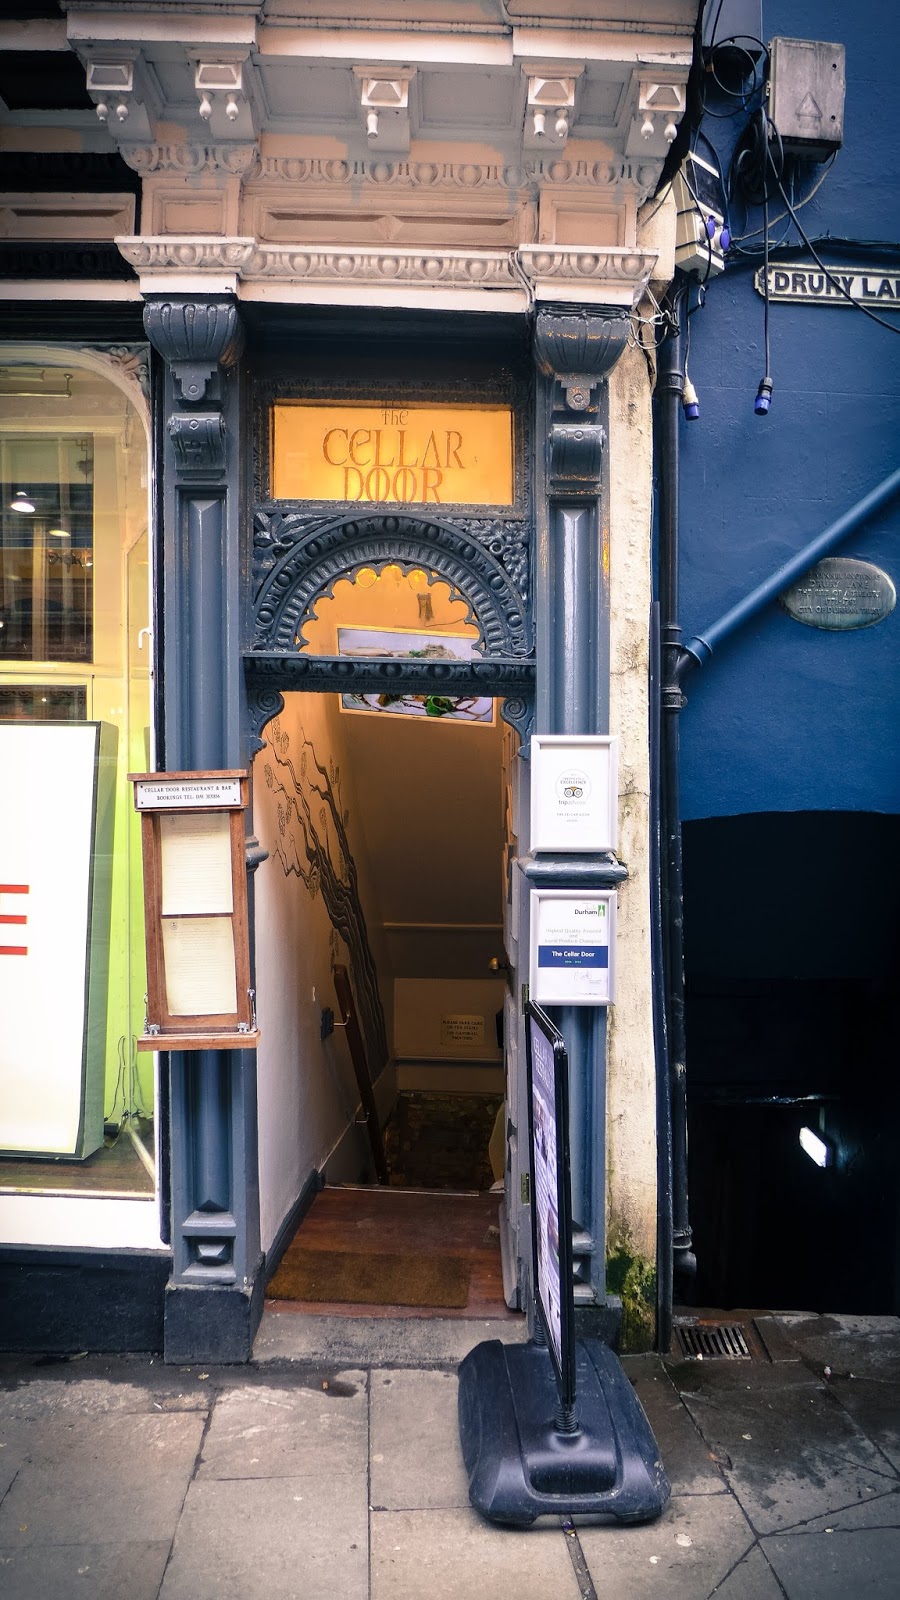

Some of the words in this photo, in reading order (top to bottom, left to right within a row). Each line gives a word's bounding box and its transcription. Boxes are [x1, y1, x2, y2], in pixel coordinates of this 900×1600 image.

[774, 271, 854, 297] DRURY
[861, 277, 900, 299] LA
[322, 428, 465, 469] CELLAR
[343, 466, 443, 503] DOOR
[809, 579, 840, 589] DRURY
[798, 605, 814, 614] CITY
[815, 605, 826, 614] OF
[827, 606, 858, 615] DURHAM
[581, 950, 596, 958] Door
